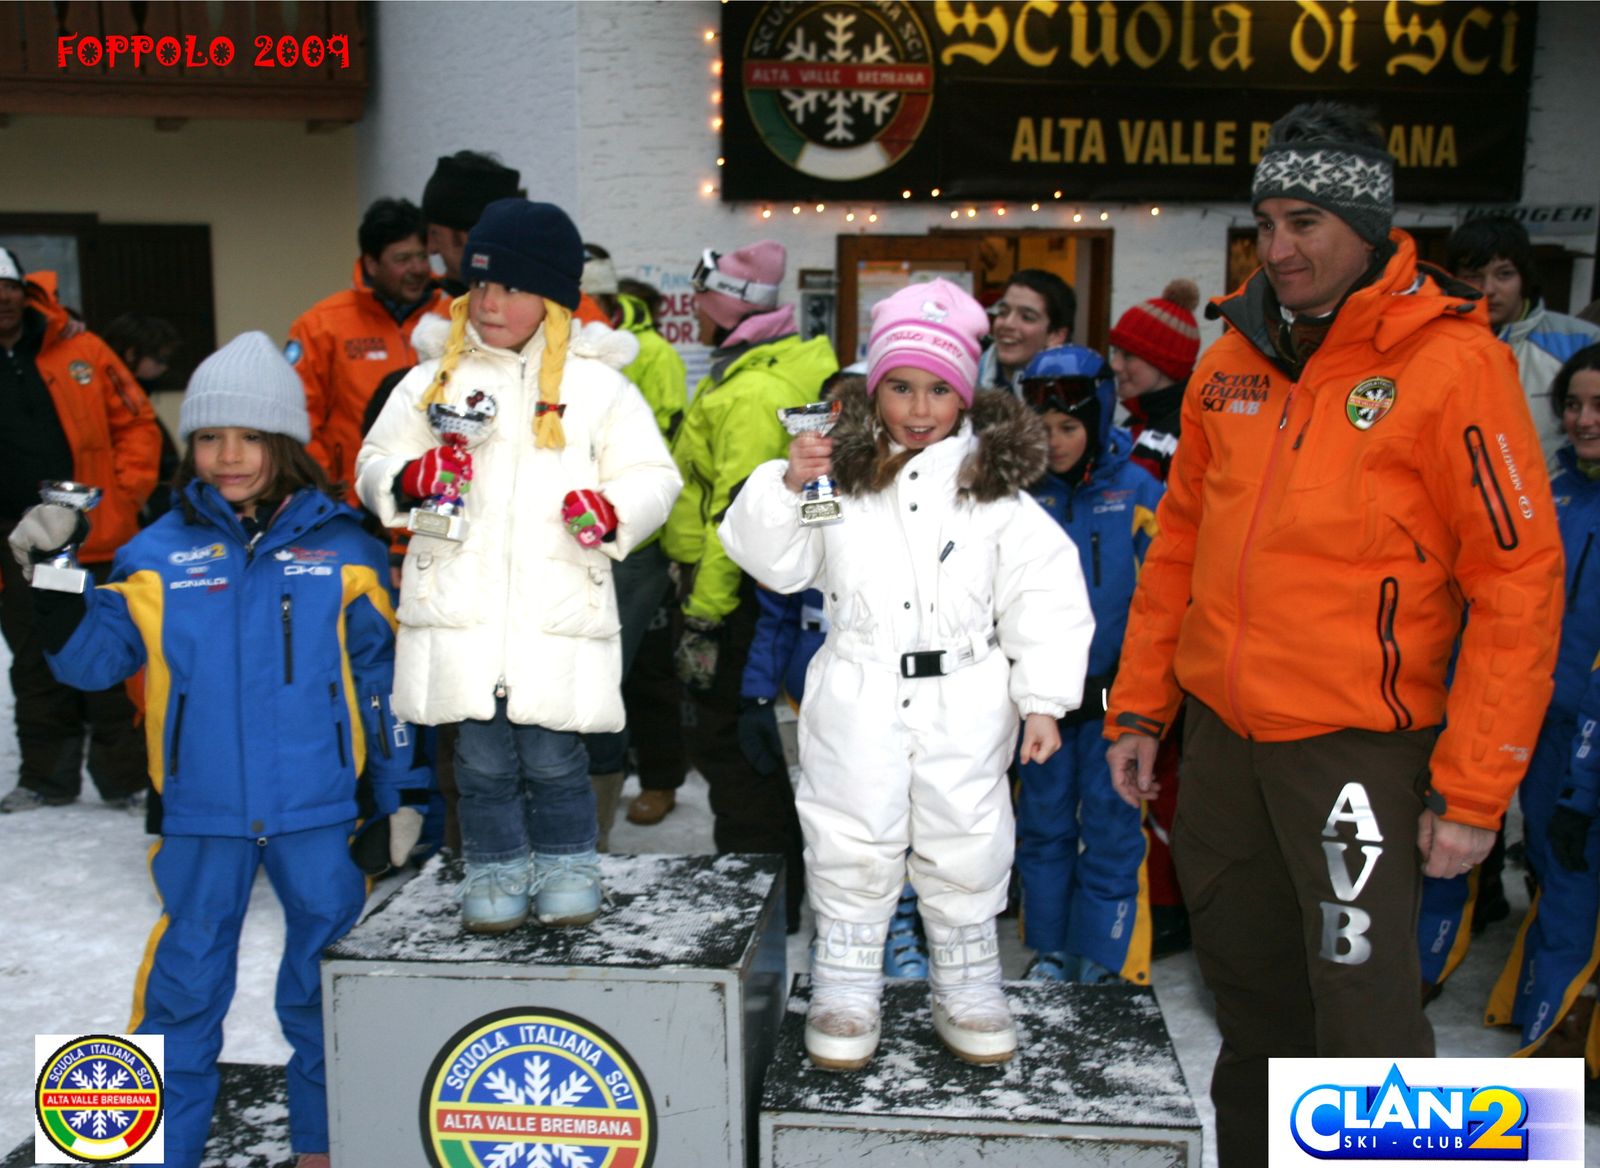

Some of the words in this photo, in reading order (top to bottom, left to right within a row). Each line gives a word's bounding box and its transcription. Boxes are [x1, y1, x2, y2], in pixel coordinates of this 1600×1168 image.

[935, 2, 1254, 71] Scuola
[1290, 2, 1359, 74] di
[1384, 2, 1520, 76] Sci
[752, 67, 790, 83] ALTA
[800, 69, 841, 85] VALLE
[857, 70, 925, 86] BREMBANA
[1011, 117, 1107, 163] ALTA
[1118, 119, 1237, 165] VALLE
[1250, 121, 1458, 167] BANA
[1201, 383, 1268, 402] ITALIANA
[1212, 371, 1270, 389] SCUOLA
[1203, 398, 1225, 412] SCI
[1226, 400, 1261, 416] AVB
[1495, 432, 1522, 491] SALOMON
[1319, 781, 1384, 966] AVB
[447, 1031, 509, 1090] SCUOLA
[519, 1025, 602, 1067] ITALIANA
[604, 1070, 633, 1102] SCI
[443, 1113, 483, 1129] ALTA
[486, 1115, 536, 1132] VALLE
[540, 1117, 633, 1136] BREMBANA
